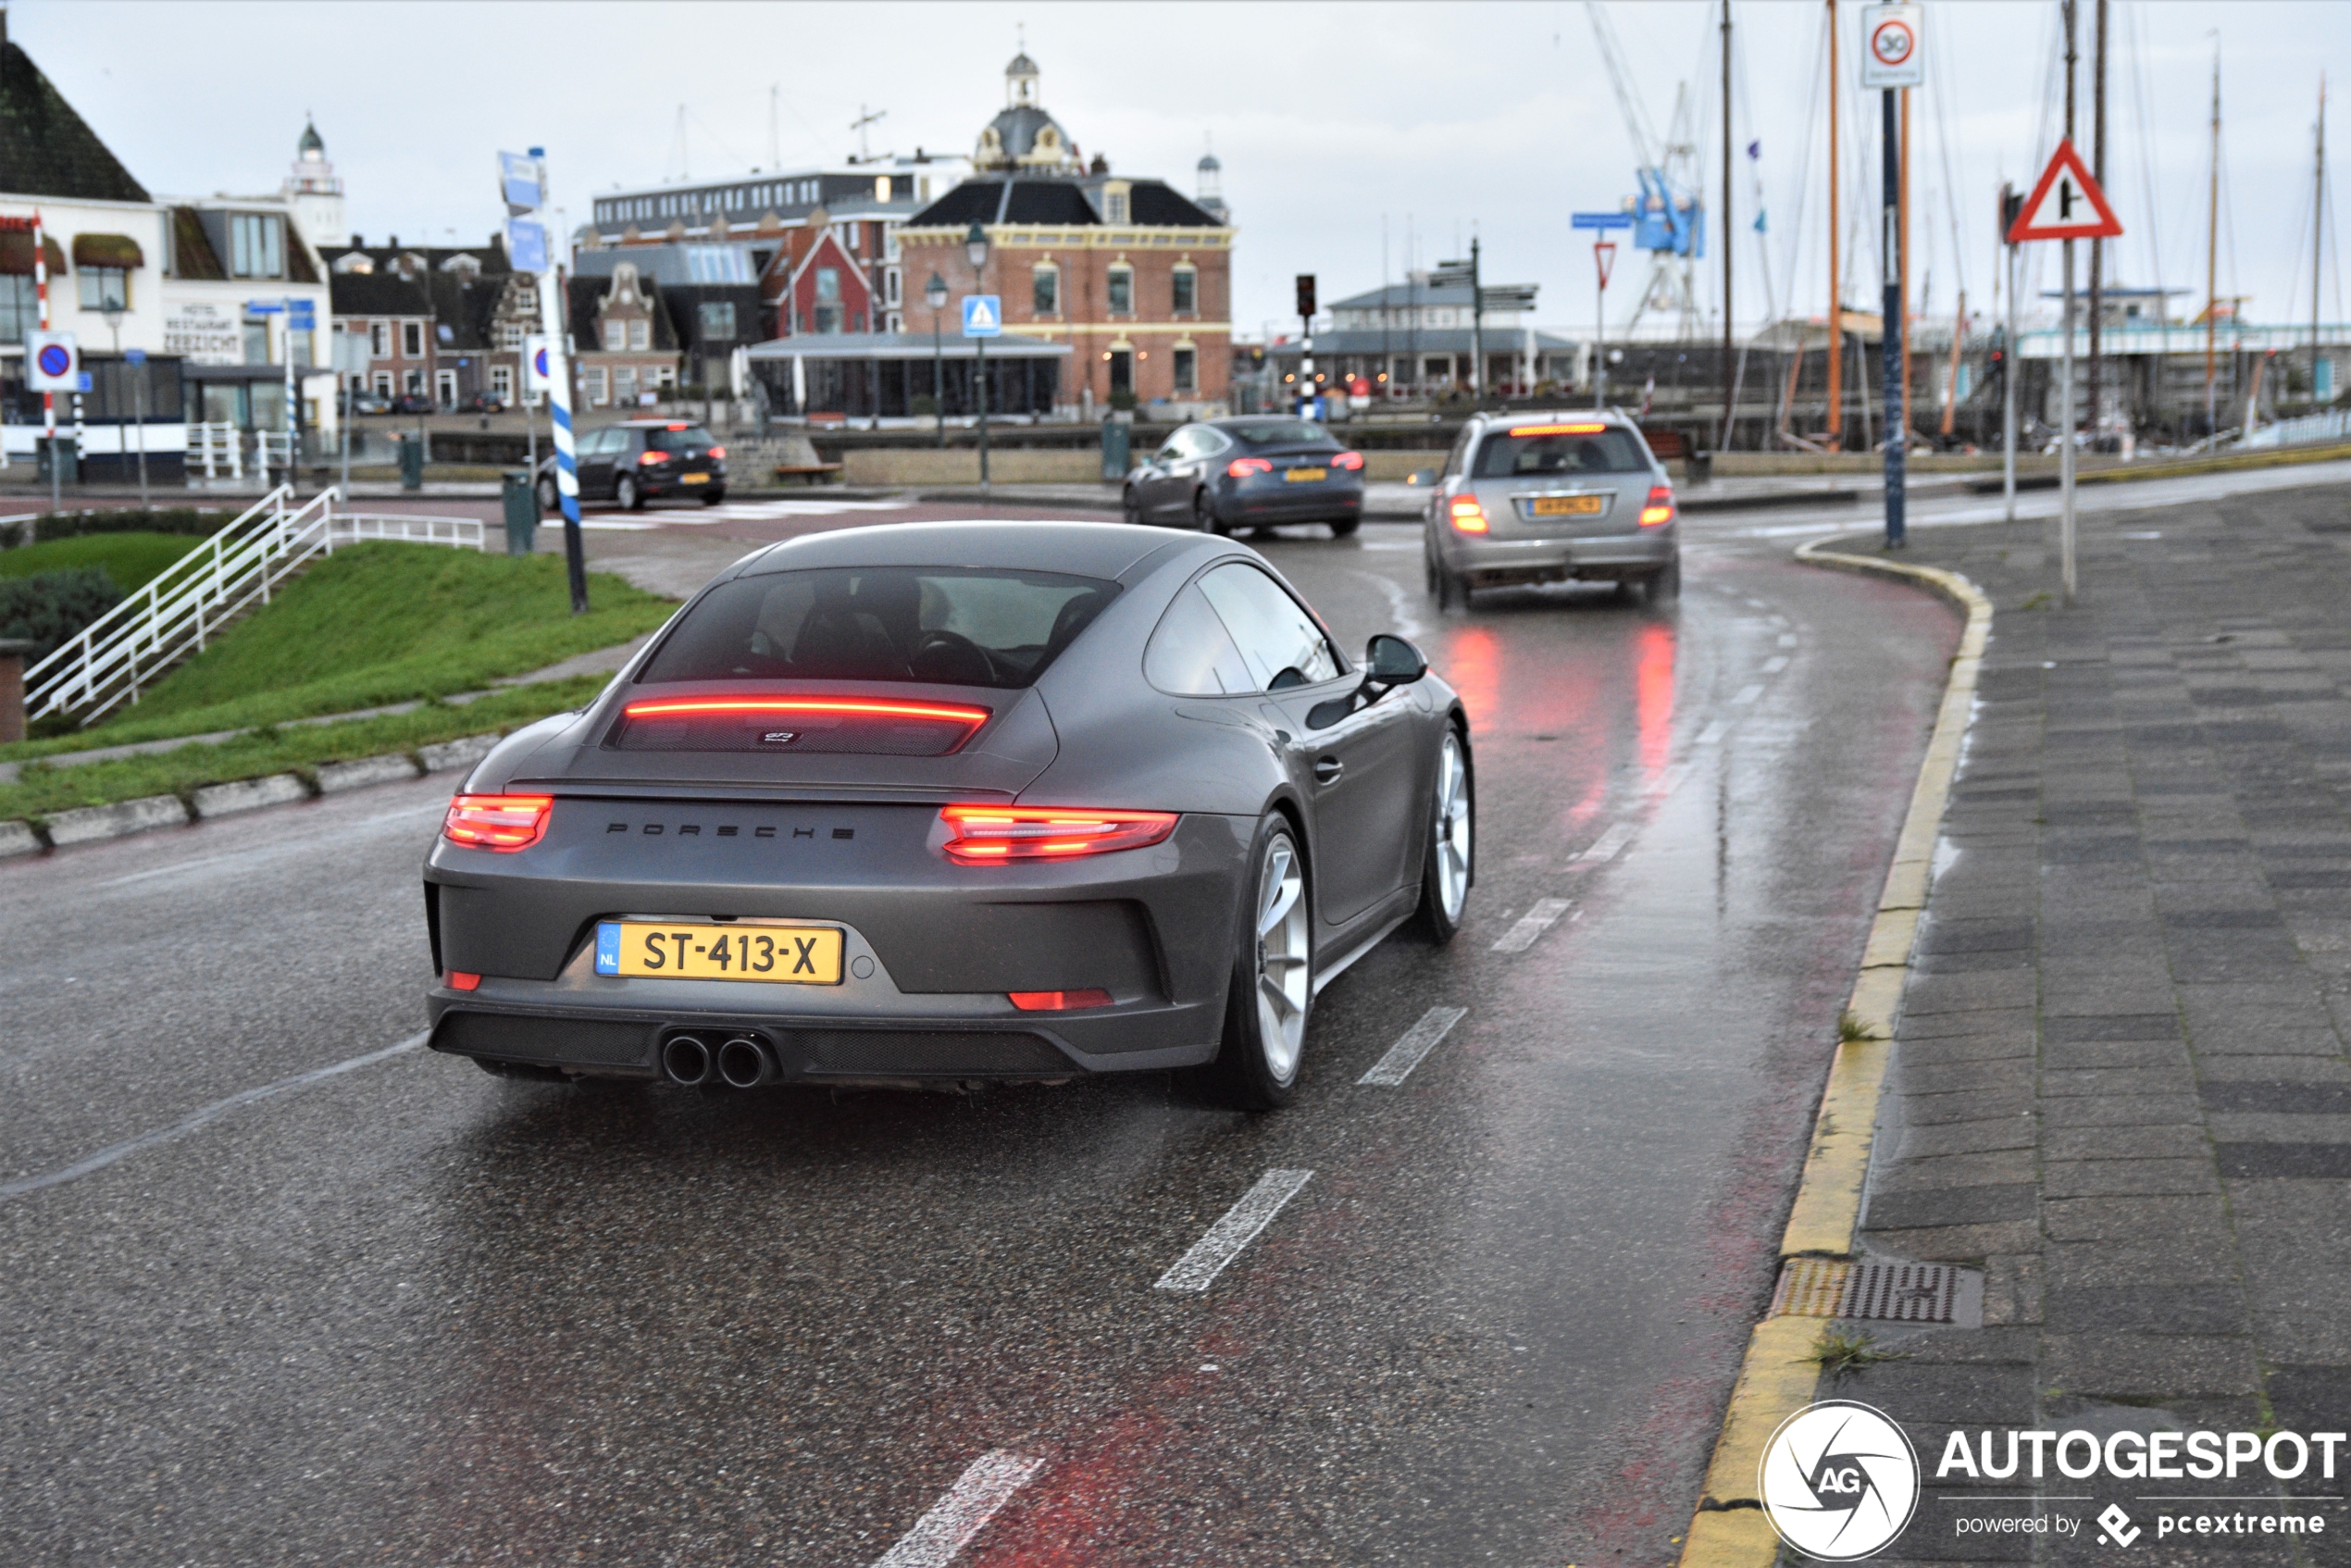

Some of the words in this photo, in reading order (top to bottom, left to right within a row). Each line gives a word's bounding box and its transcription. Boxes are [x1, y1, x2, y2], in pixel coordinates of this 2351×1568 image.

[1881, 33, 1909, 54] 30
[606, 822, 854, 840] PORSCHE
[600, 953, 616, 966] NL
[643, 932, 817, 975] ST-413-X
